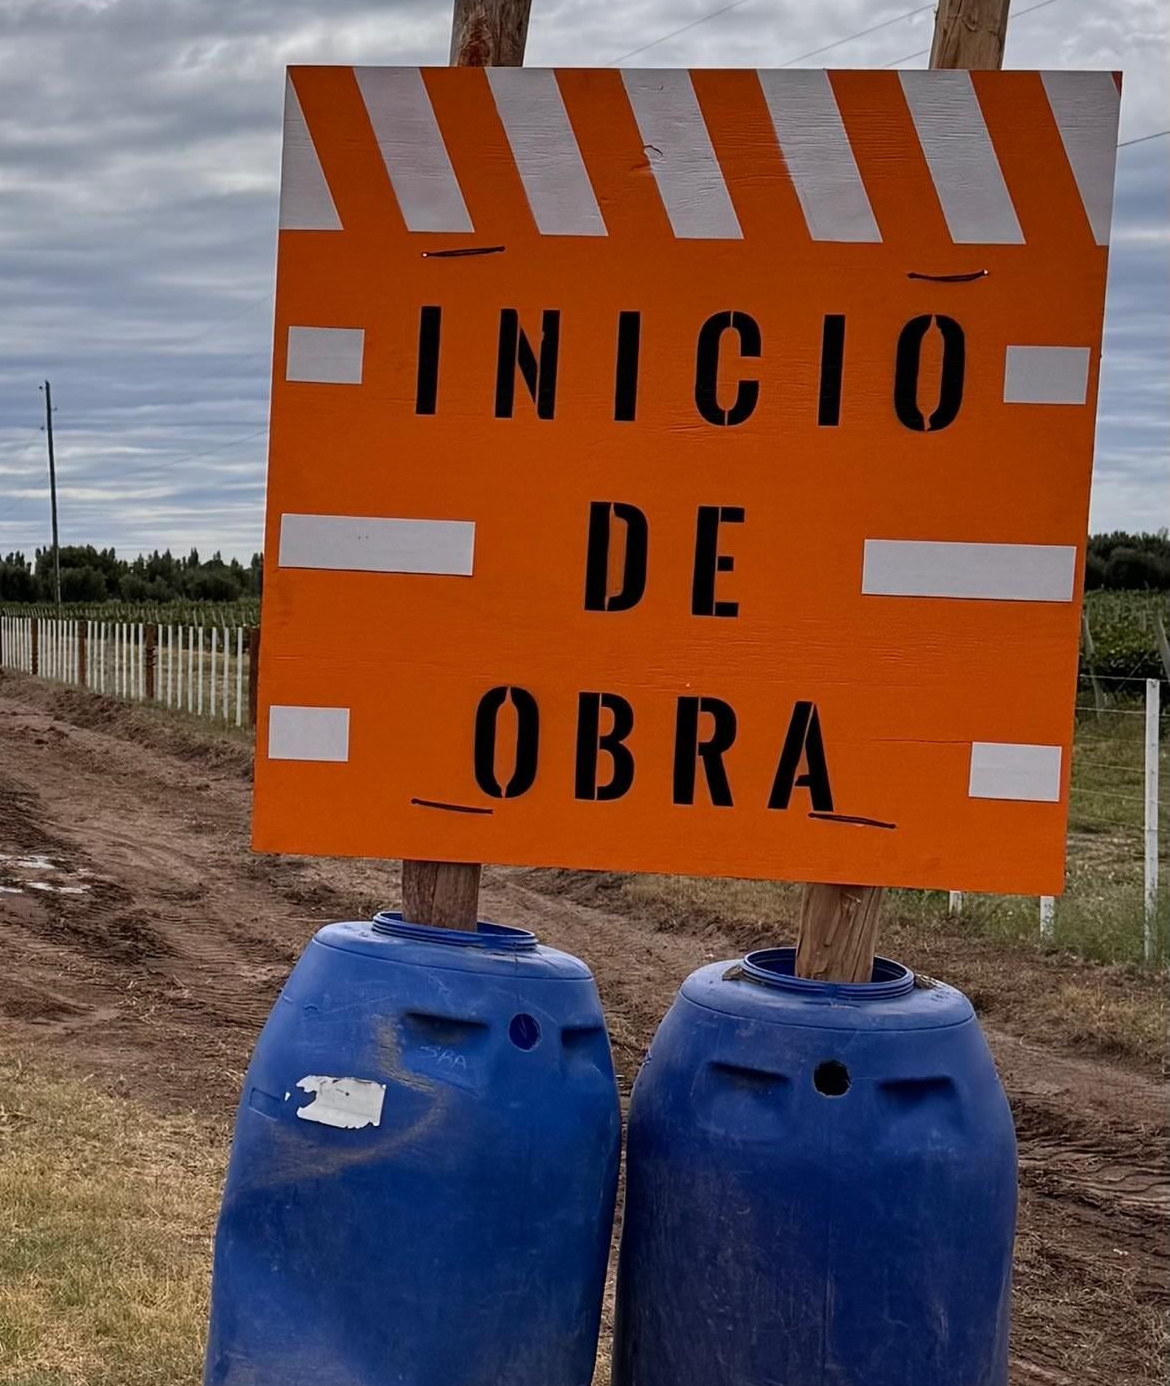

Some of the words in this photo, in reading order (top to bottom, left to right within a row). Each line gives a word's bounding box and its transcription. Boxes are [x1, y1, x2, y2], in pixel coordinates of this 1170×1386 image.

[415, 305, 966, 432] INICIO
[584, 501, 746, 618] DE
[473, 685, 835, 813] OBRA
